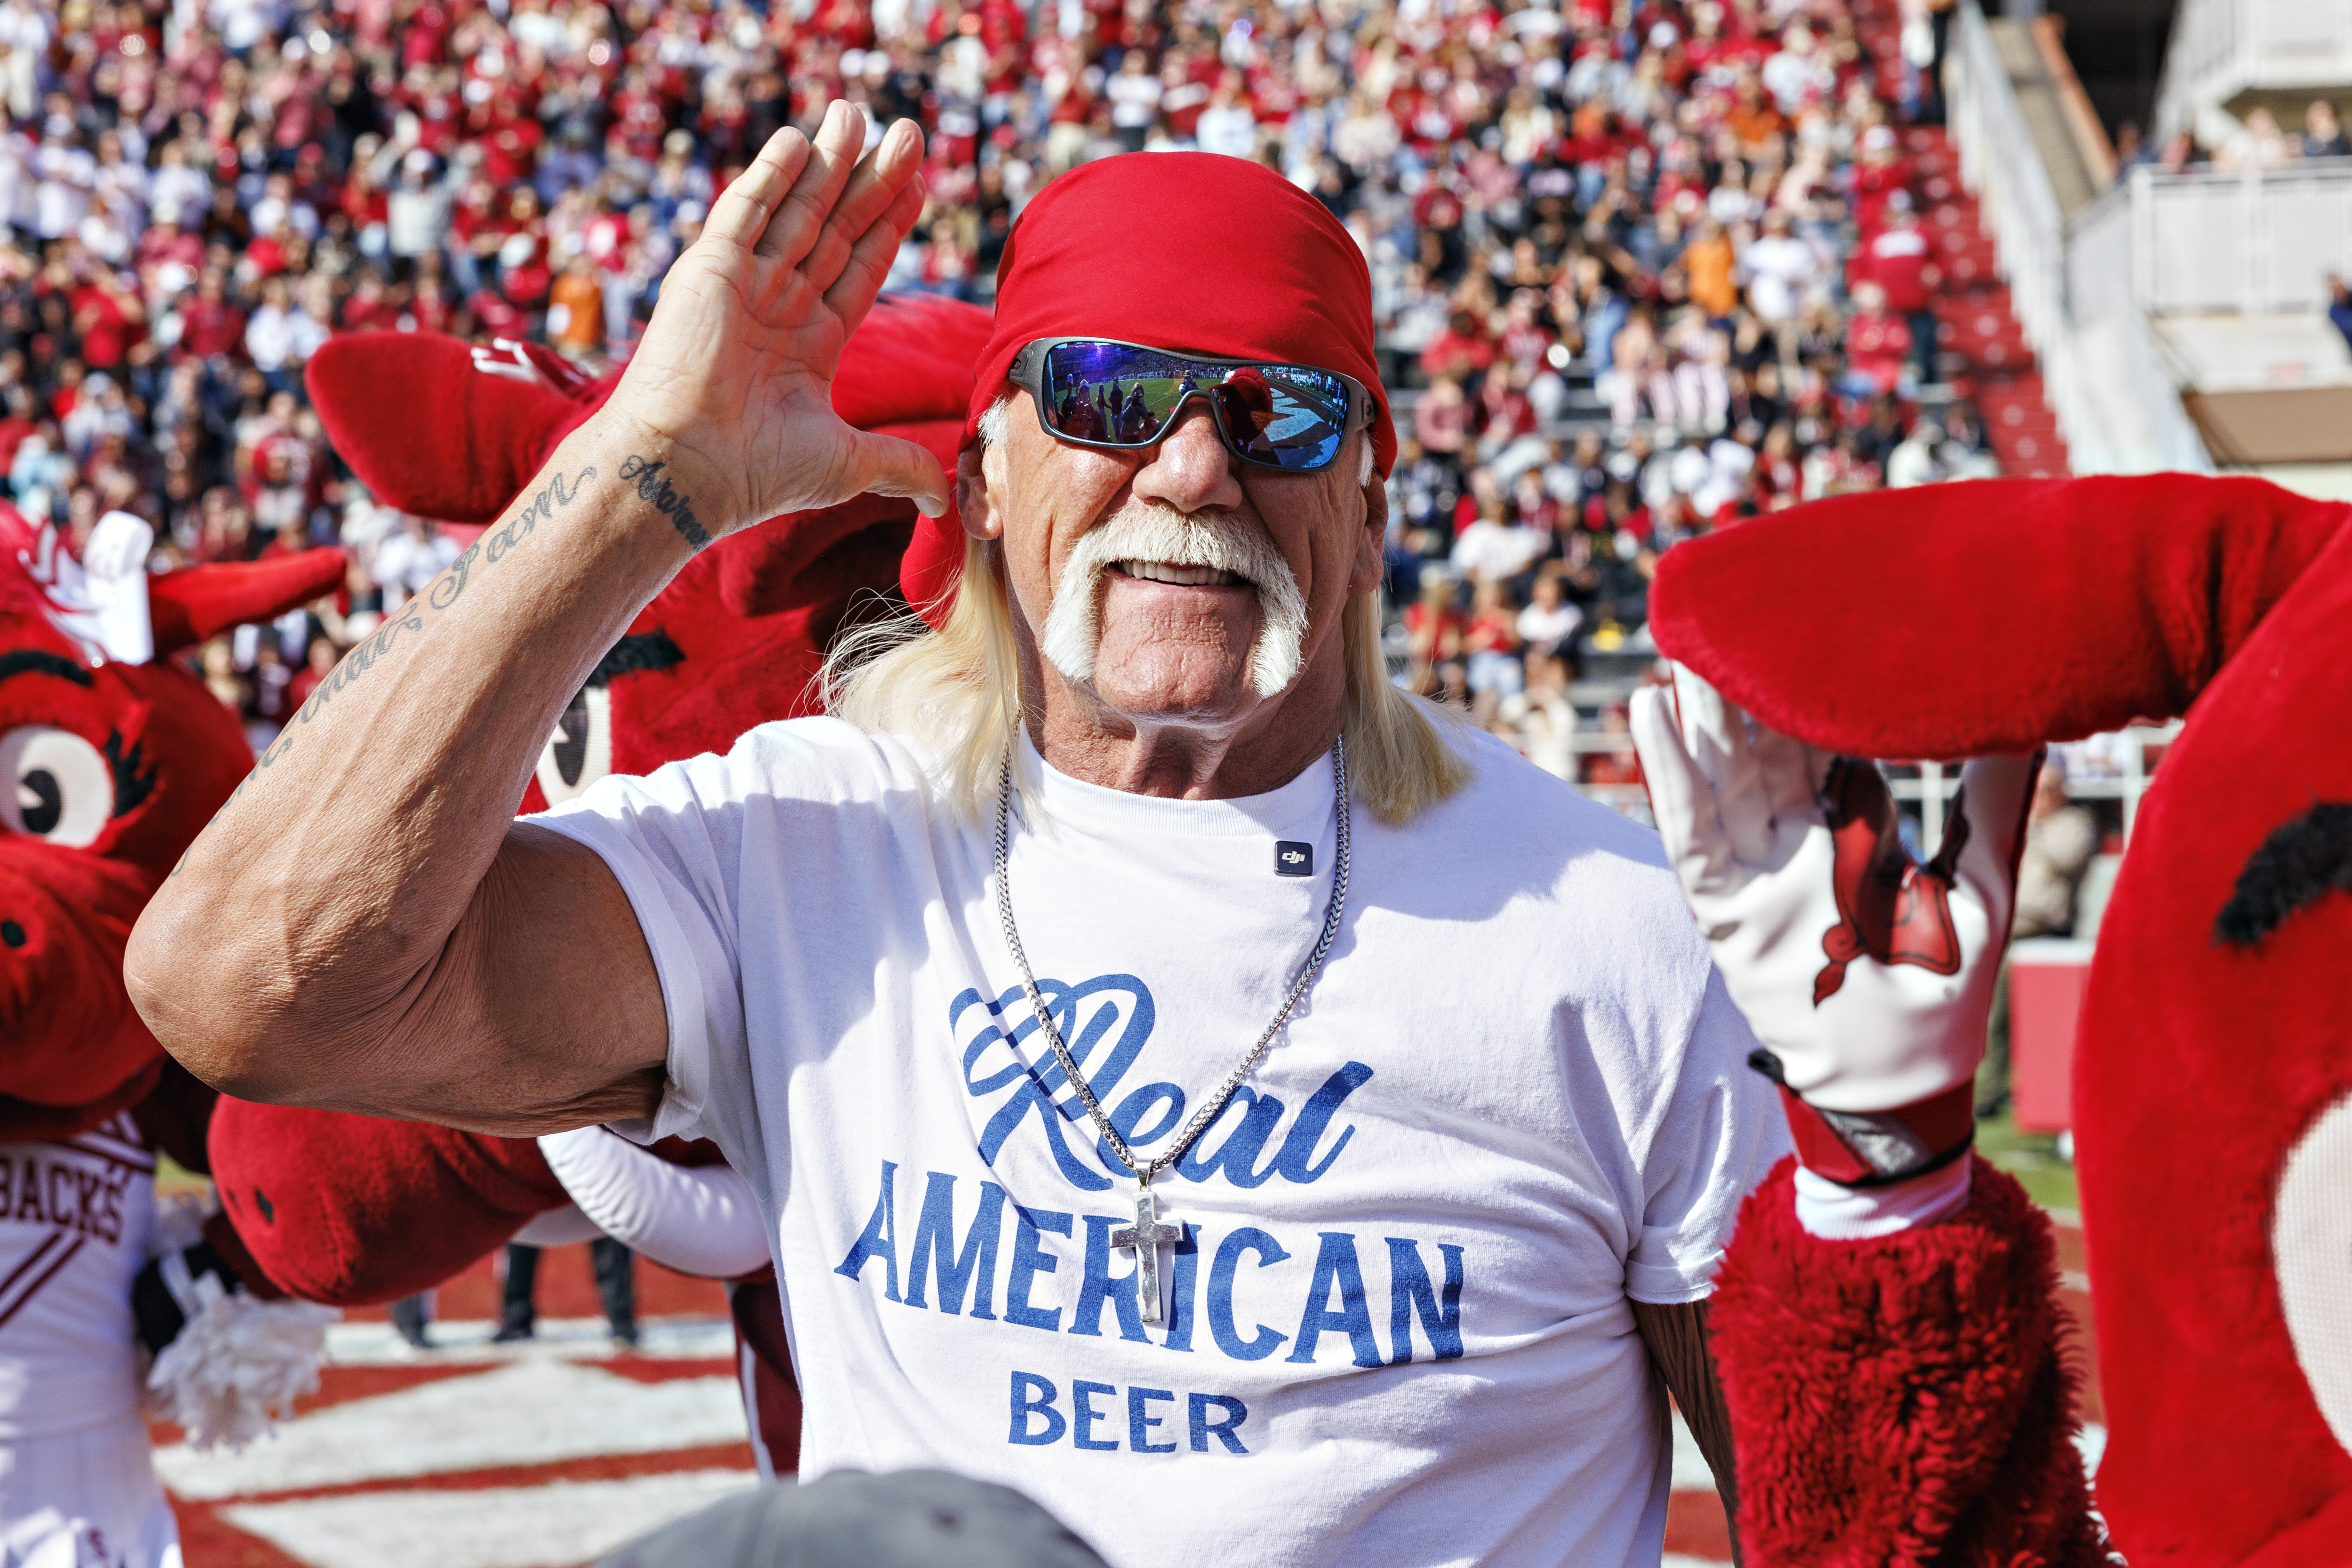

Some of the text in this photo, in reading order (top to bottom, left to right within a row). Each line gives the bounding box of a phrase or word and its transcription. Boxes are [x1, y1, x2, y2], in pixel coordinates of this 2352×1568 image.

[487, 466, 597, 563] am
[949, 973, 1374, 1191] Real
[834, 1158, 1465, 1369] AMERICAN
[1008, 1369, 1250, 1454] BEER
